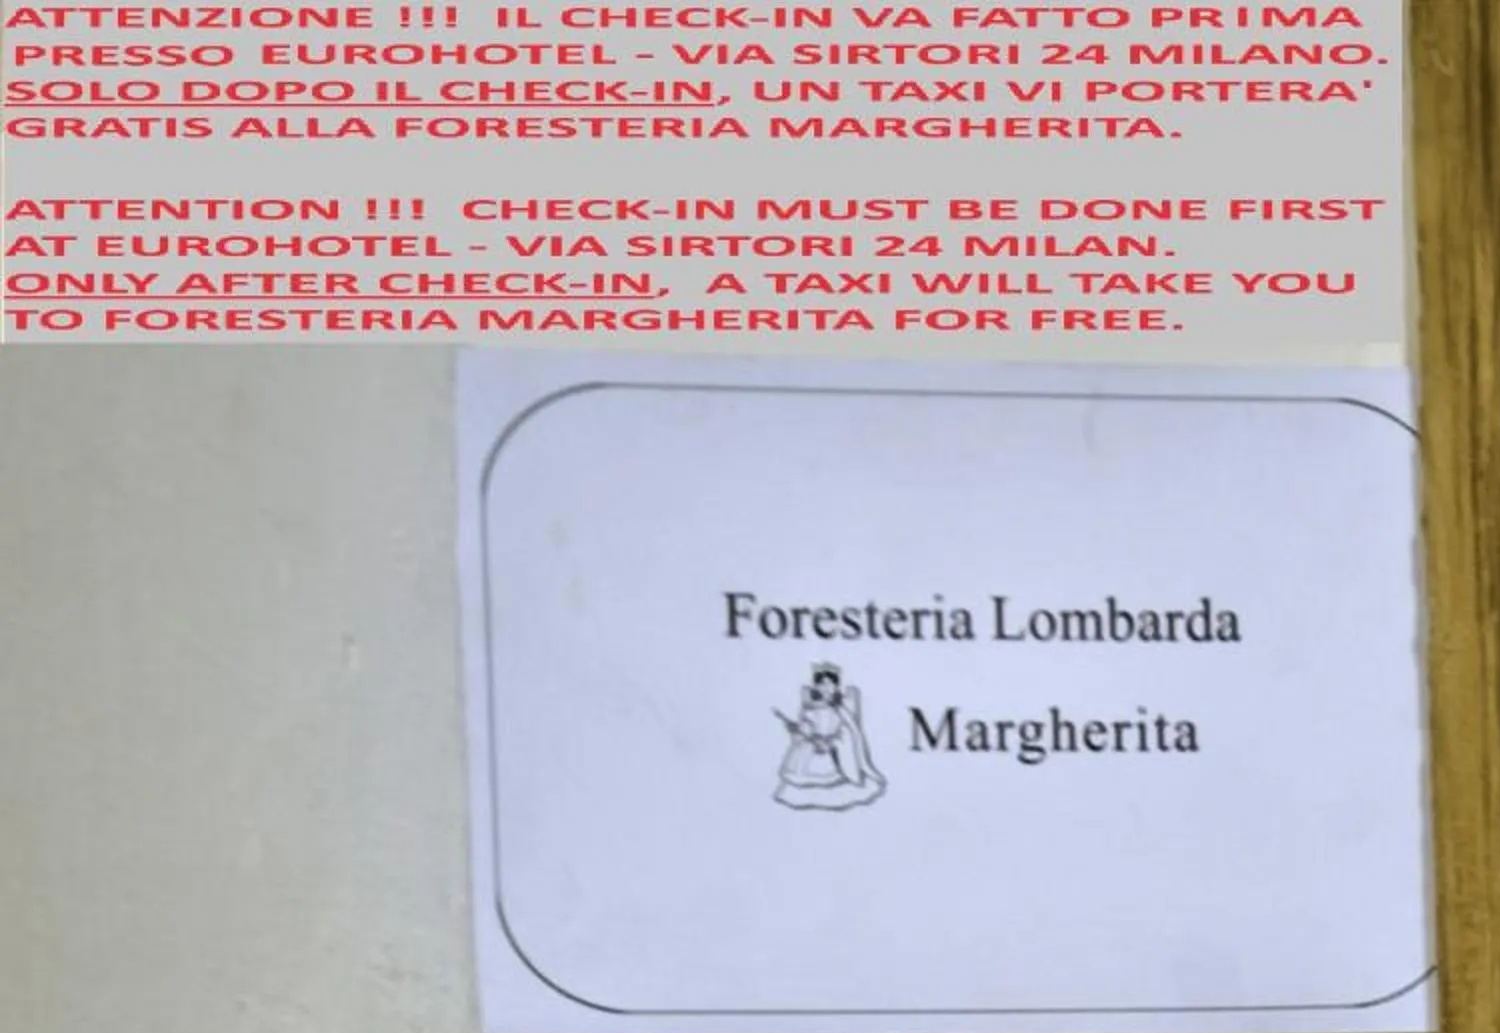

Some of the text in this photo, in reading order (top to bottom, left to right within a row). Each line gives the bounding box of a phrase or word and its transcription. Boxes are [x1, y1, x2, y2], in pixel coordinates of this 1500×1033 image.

[723, 592, 1242, 643] Foresteria Lombarda
[908, 706, 1199, 764] Margherita
